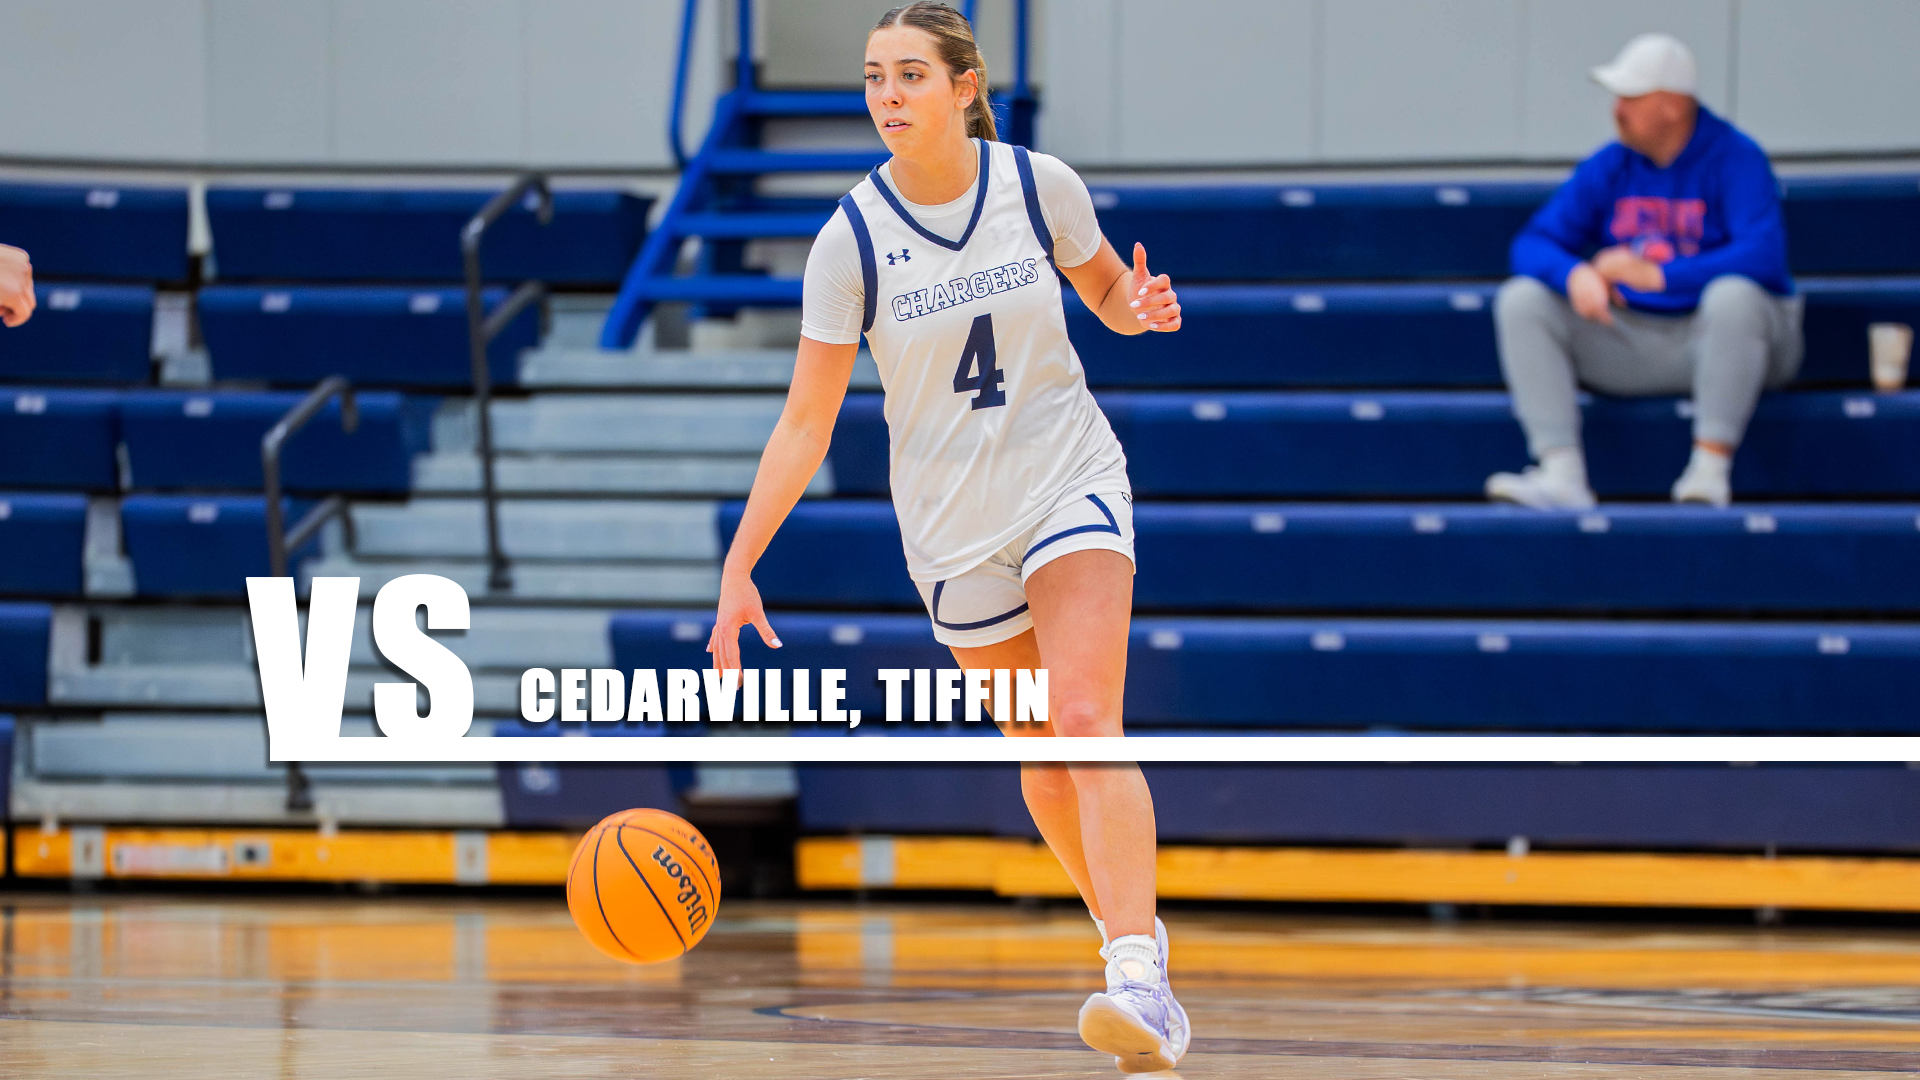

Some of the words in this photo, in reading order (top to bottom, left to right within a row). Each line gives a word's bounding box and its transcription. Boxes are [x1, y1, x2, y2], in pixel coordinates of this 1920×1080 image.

[892, 258, 1039, 321] CHARGERS
[953, 313, 1006, 411] 4
[651, 844, 708, 936] Wilson
